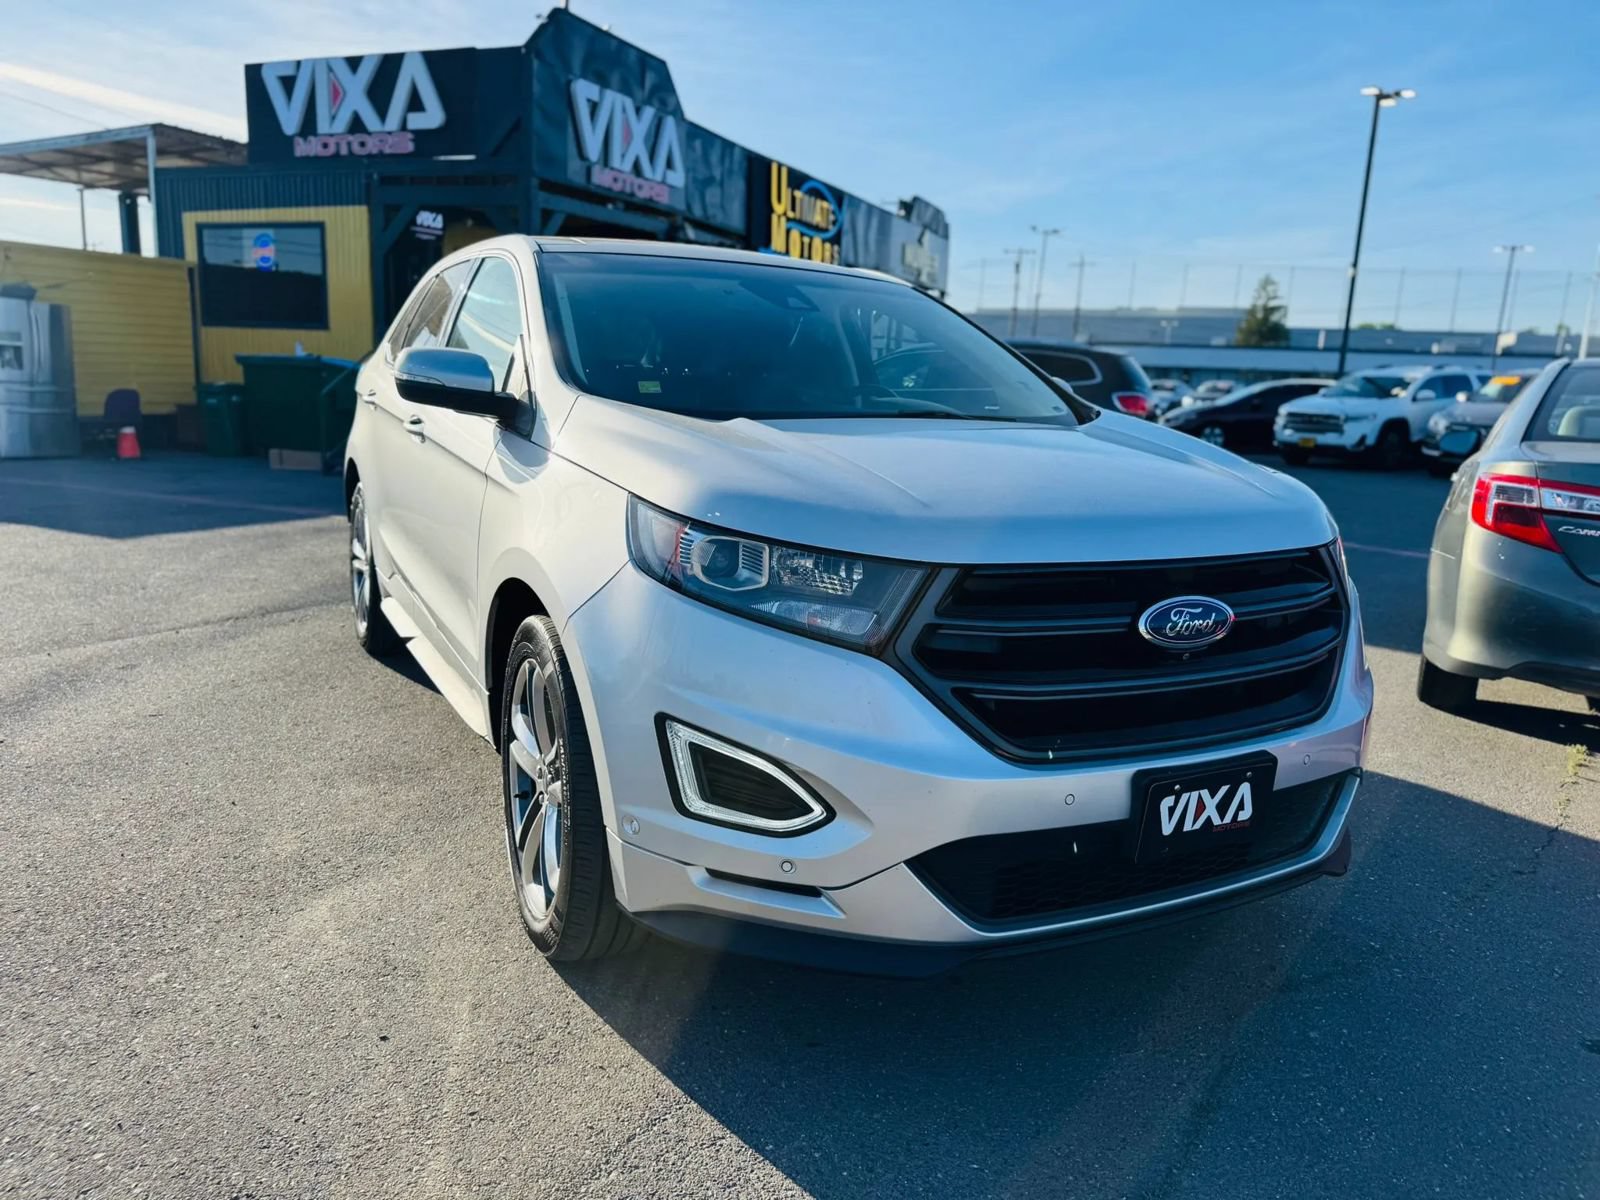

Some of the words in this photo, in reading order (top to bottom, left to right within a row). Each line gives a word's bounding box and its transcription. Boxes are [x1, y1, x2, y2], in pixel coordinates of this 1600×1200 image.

[261, 51, 446, 136] VIXA
[293, 131, 416, 157] MOTORS
[569, 78, 686, 189] VIXA
[591, 164, 670, 204] MOTORS
[1166, 607, 1216, 636] Ford
[1160, 782, 1253, 836] VIXA
